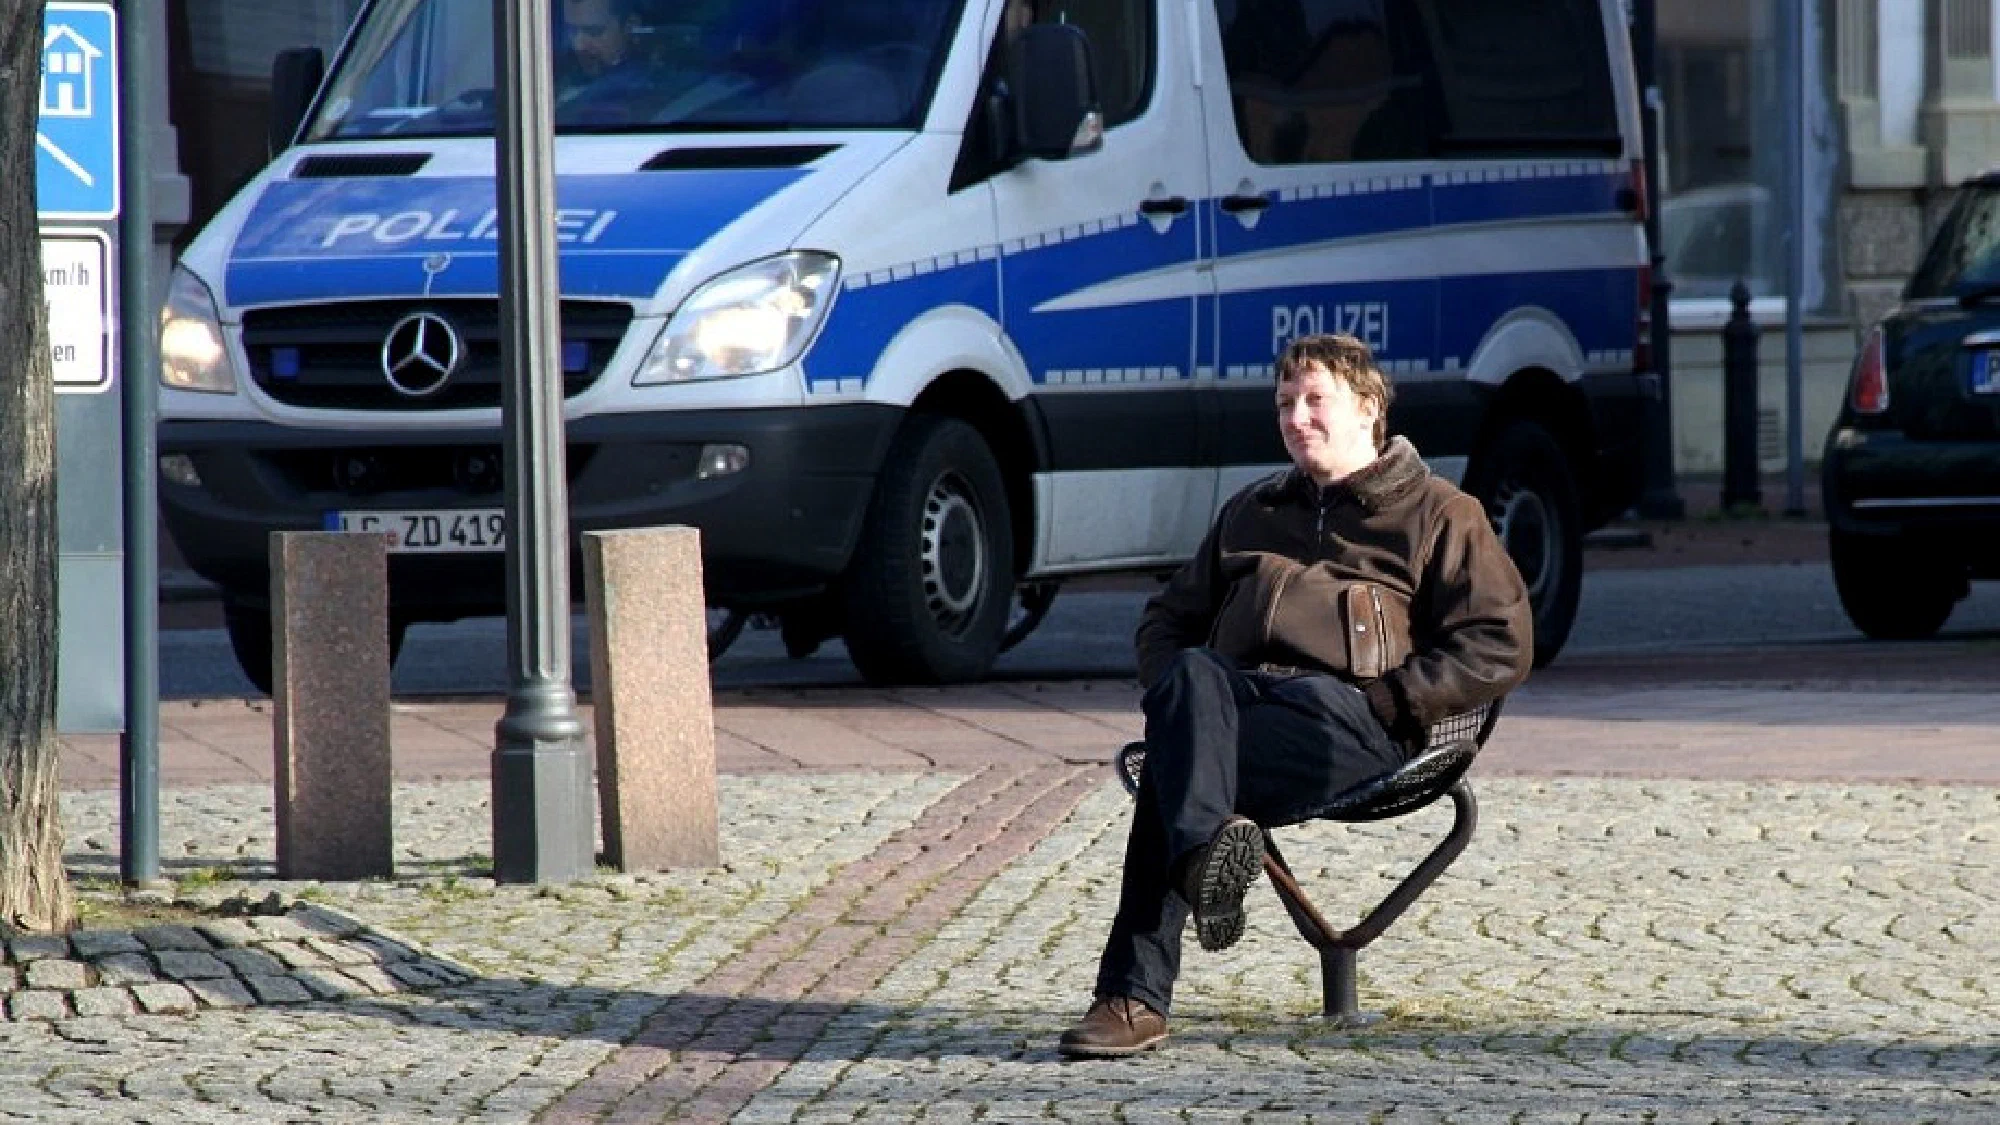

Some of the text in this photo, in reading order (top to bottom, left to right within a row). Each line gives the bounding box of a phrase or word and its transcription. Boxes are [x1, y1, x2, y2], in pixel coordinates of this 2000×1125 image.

[321, 208, 618, 248] POLIEI
[402, 515, 442, 547] ZD
[449, 514, 505, 546] 419
